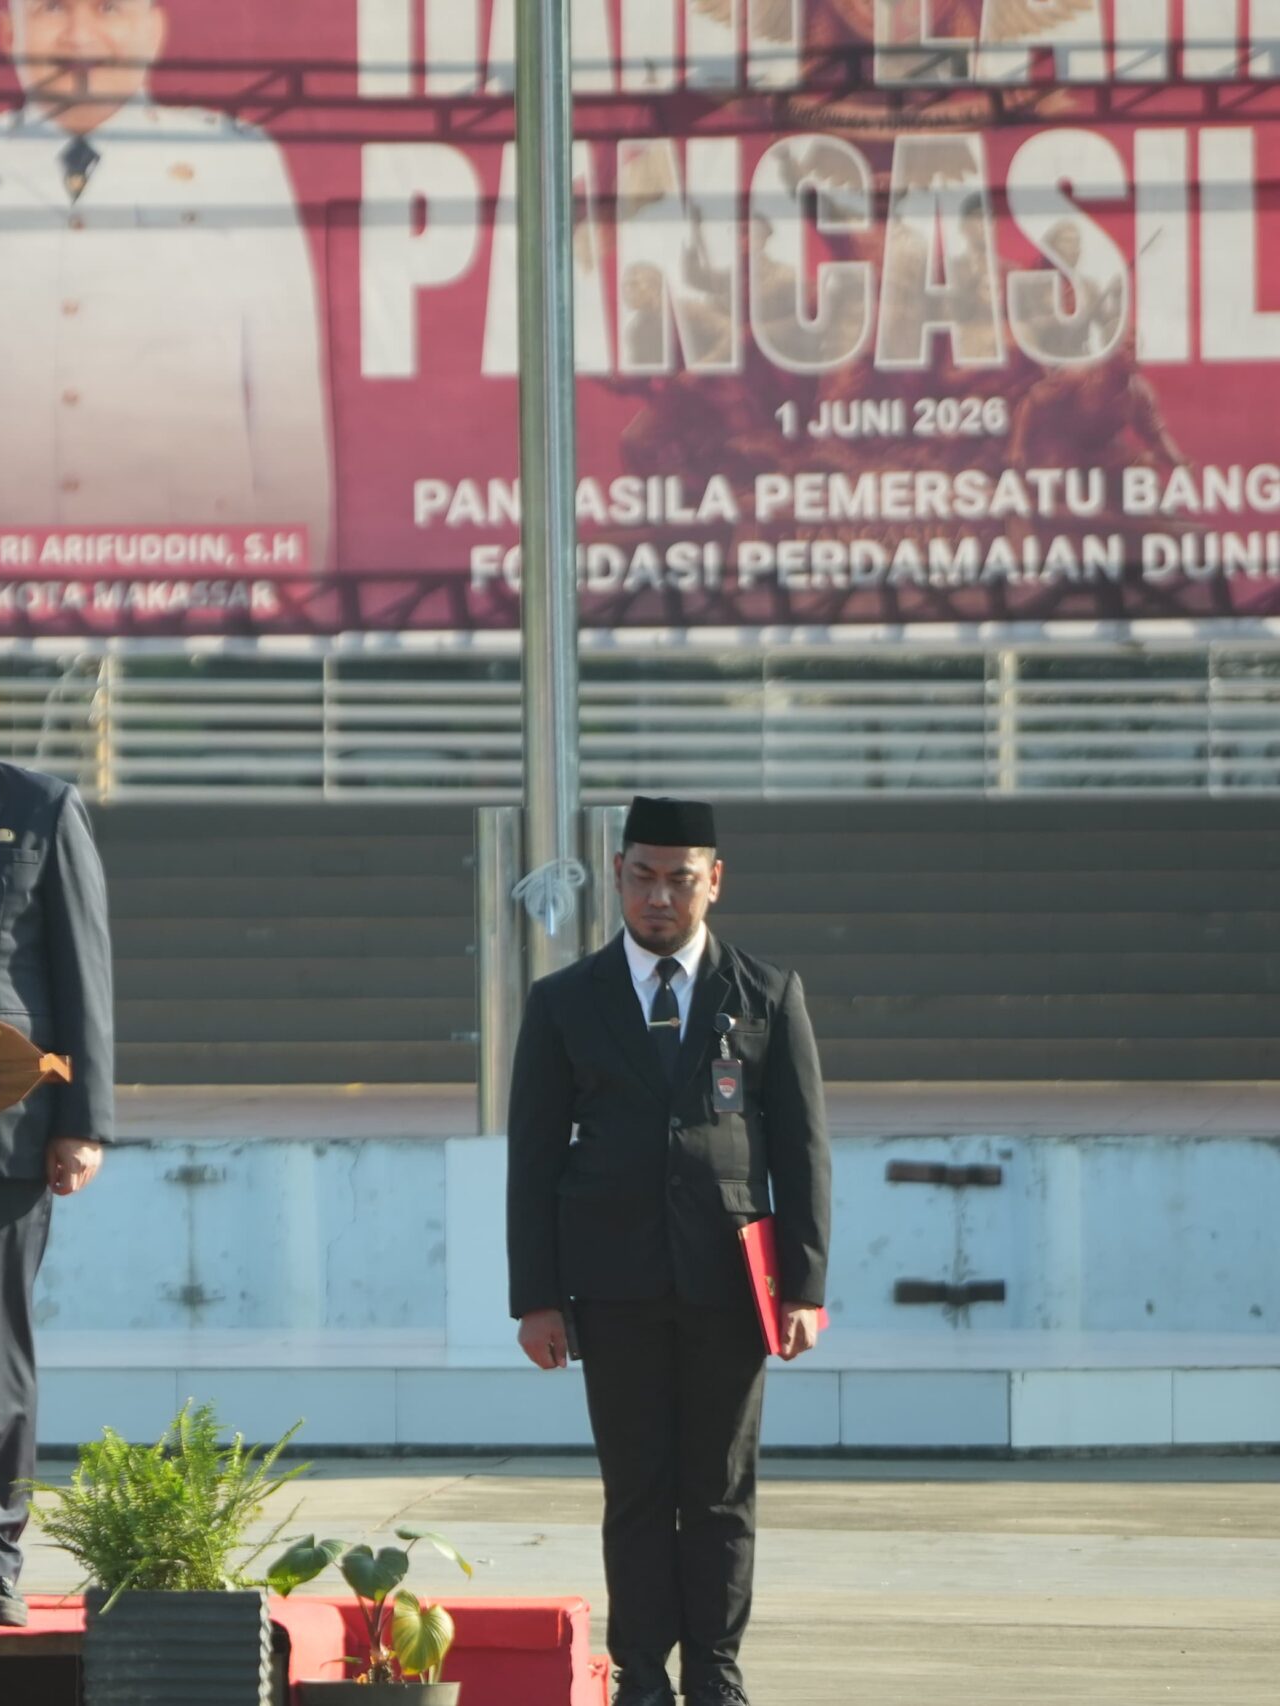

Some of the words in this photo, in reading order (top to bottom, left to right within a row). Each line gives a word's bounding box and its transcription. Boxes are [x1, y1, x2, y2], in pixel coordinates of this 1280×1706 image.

[775, 400, 798, 440] 1
[807, 399, 906, 438] JUNI
[913, 396, 1009, 437] 2026
[414, 474, 739, 526] PANASILA
[755, 466, 1106, 523] PEMERSATU
[39, 534, 236, 566] ARIFUDDIN,
[243, 533, 301, 562] S.H
[470, 541, 721, 594] FDASI
[738, 534, 1122, 588] PERDAMAIAN
[93, 580, 278, 610] MAKASSAR
